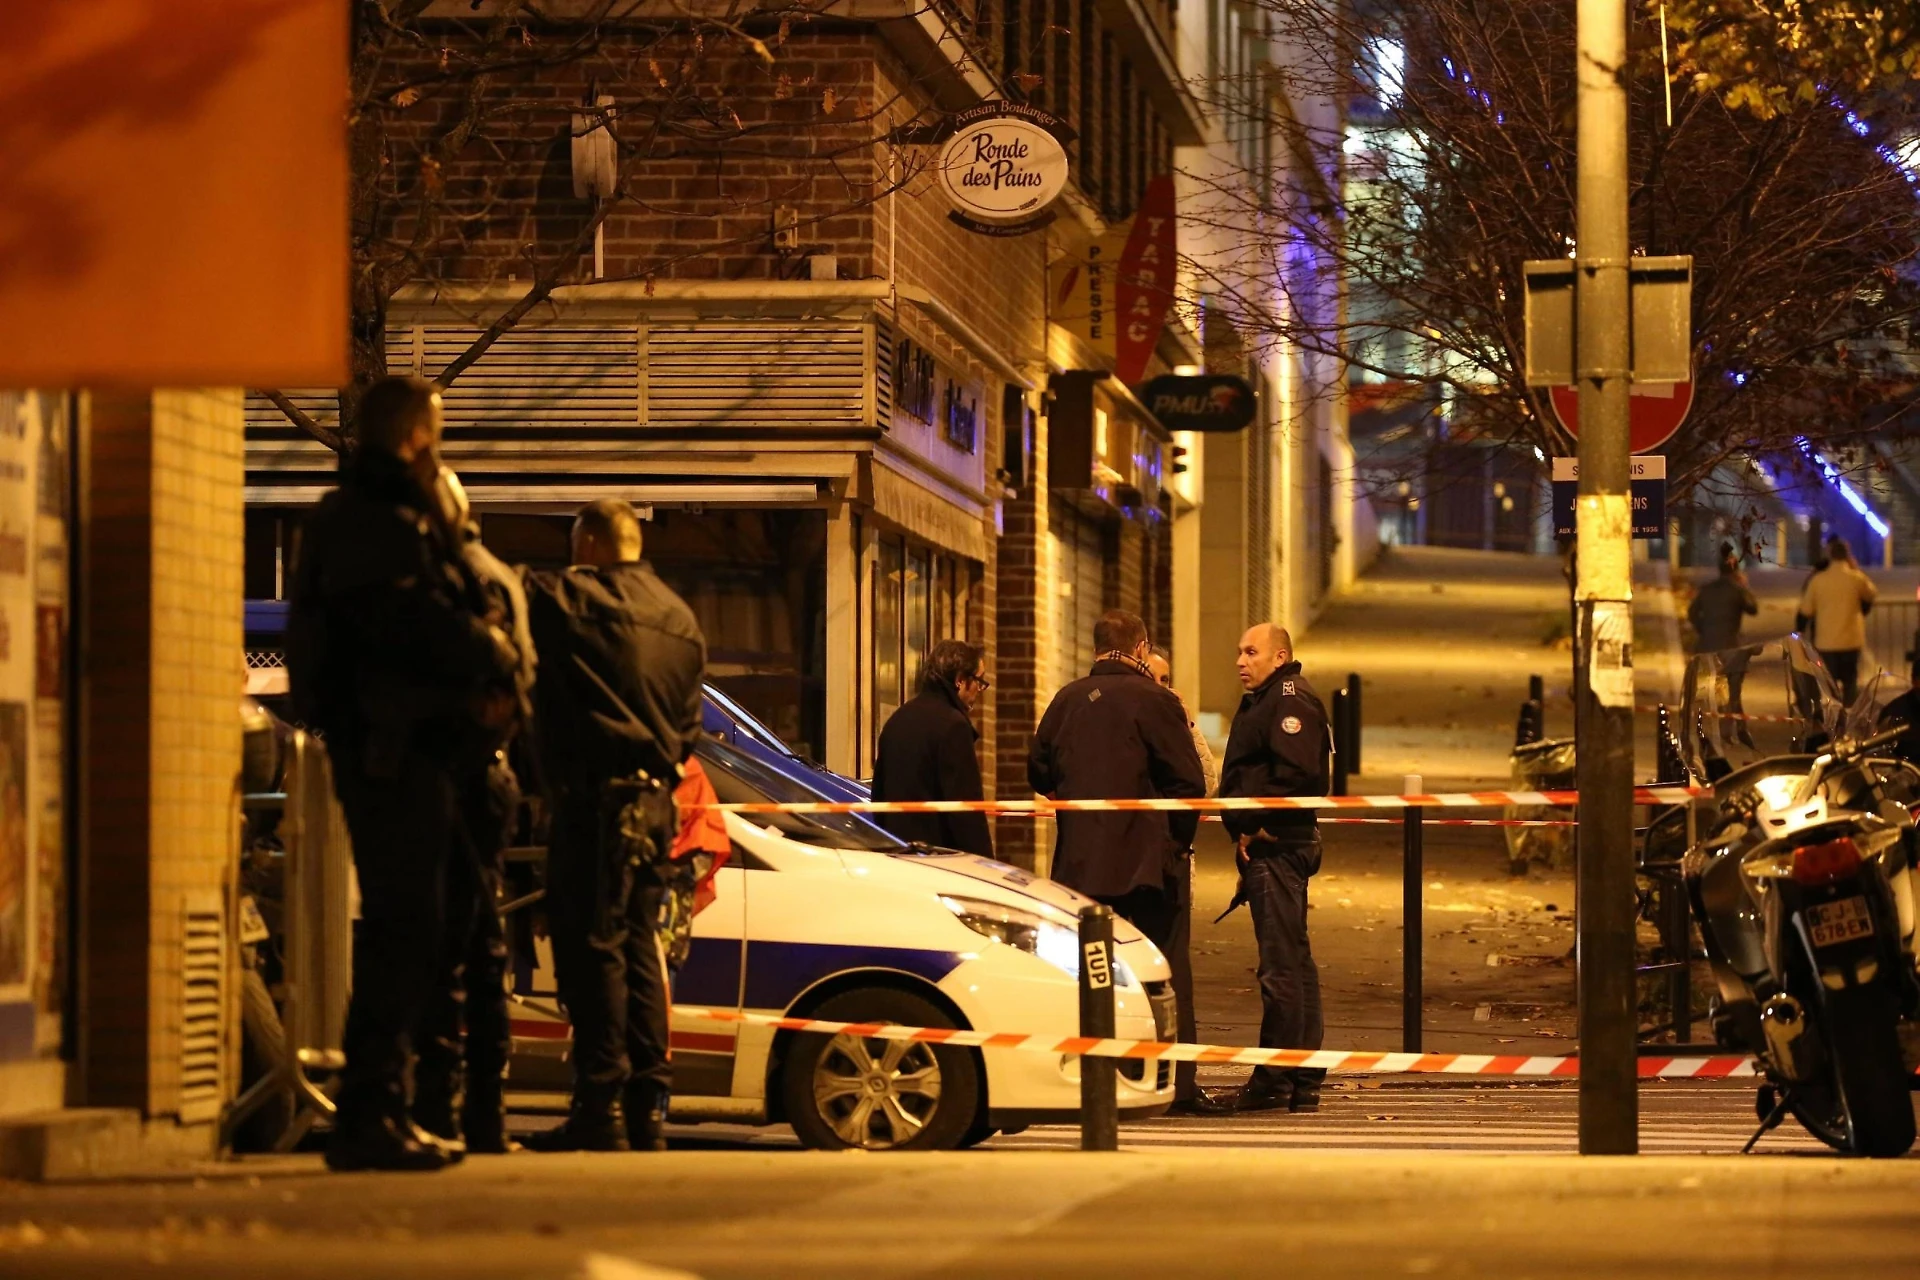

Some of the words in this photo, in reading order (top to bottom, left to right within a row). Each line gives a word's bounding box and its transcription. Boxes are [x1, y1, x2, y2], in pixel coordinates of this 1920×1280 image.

[956, 104, 996, 126] Artisan
[1000, 100, 1058, 126] Boulanger
[972, 133, 1029, 162] Ronde
[962, 166, 991, 187] des
[990, 160, 1042, 190] Pains
[1089, 246, 1102, 339] PRESSE
[1128, 217, 1165, 342] TABAC
[1153, 393, 1209, 415] PMU
[1087, 945, 1107, 985] 1UP
